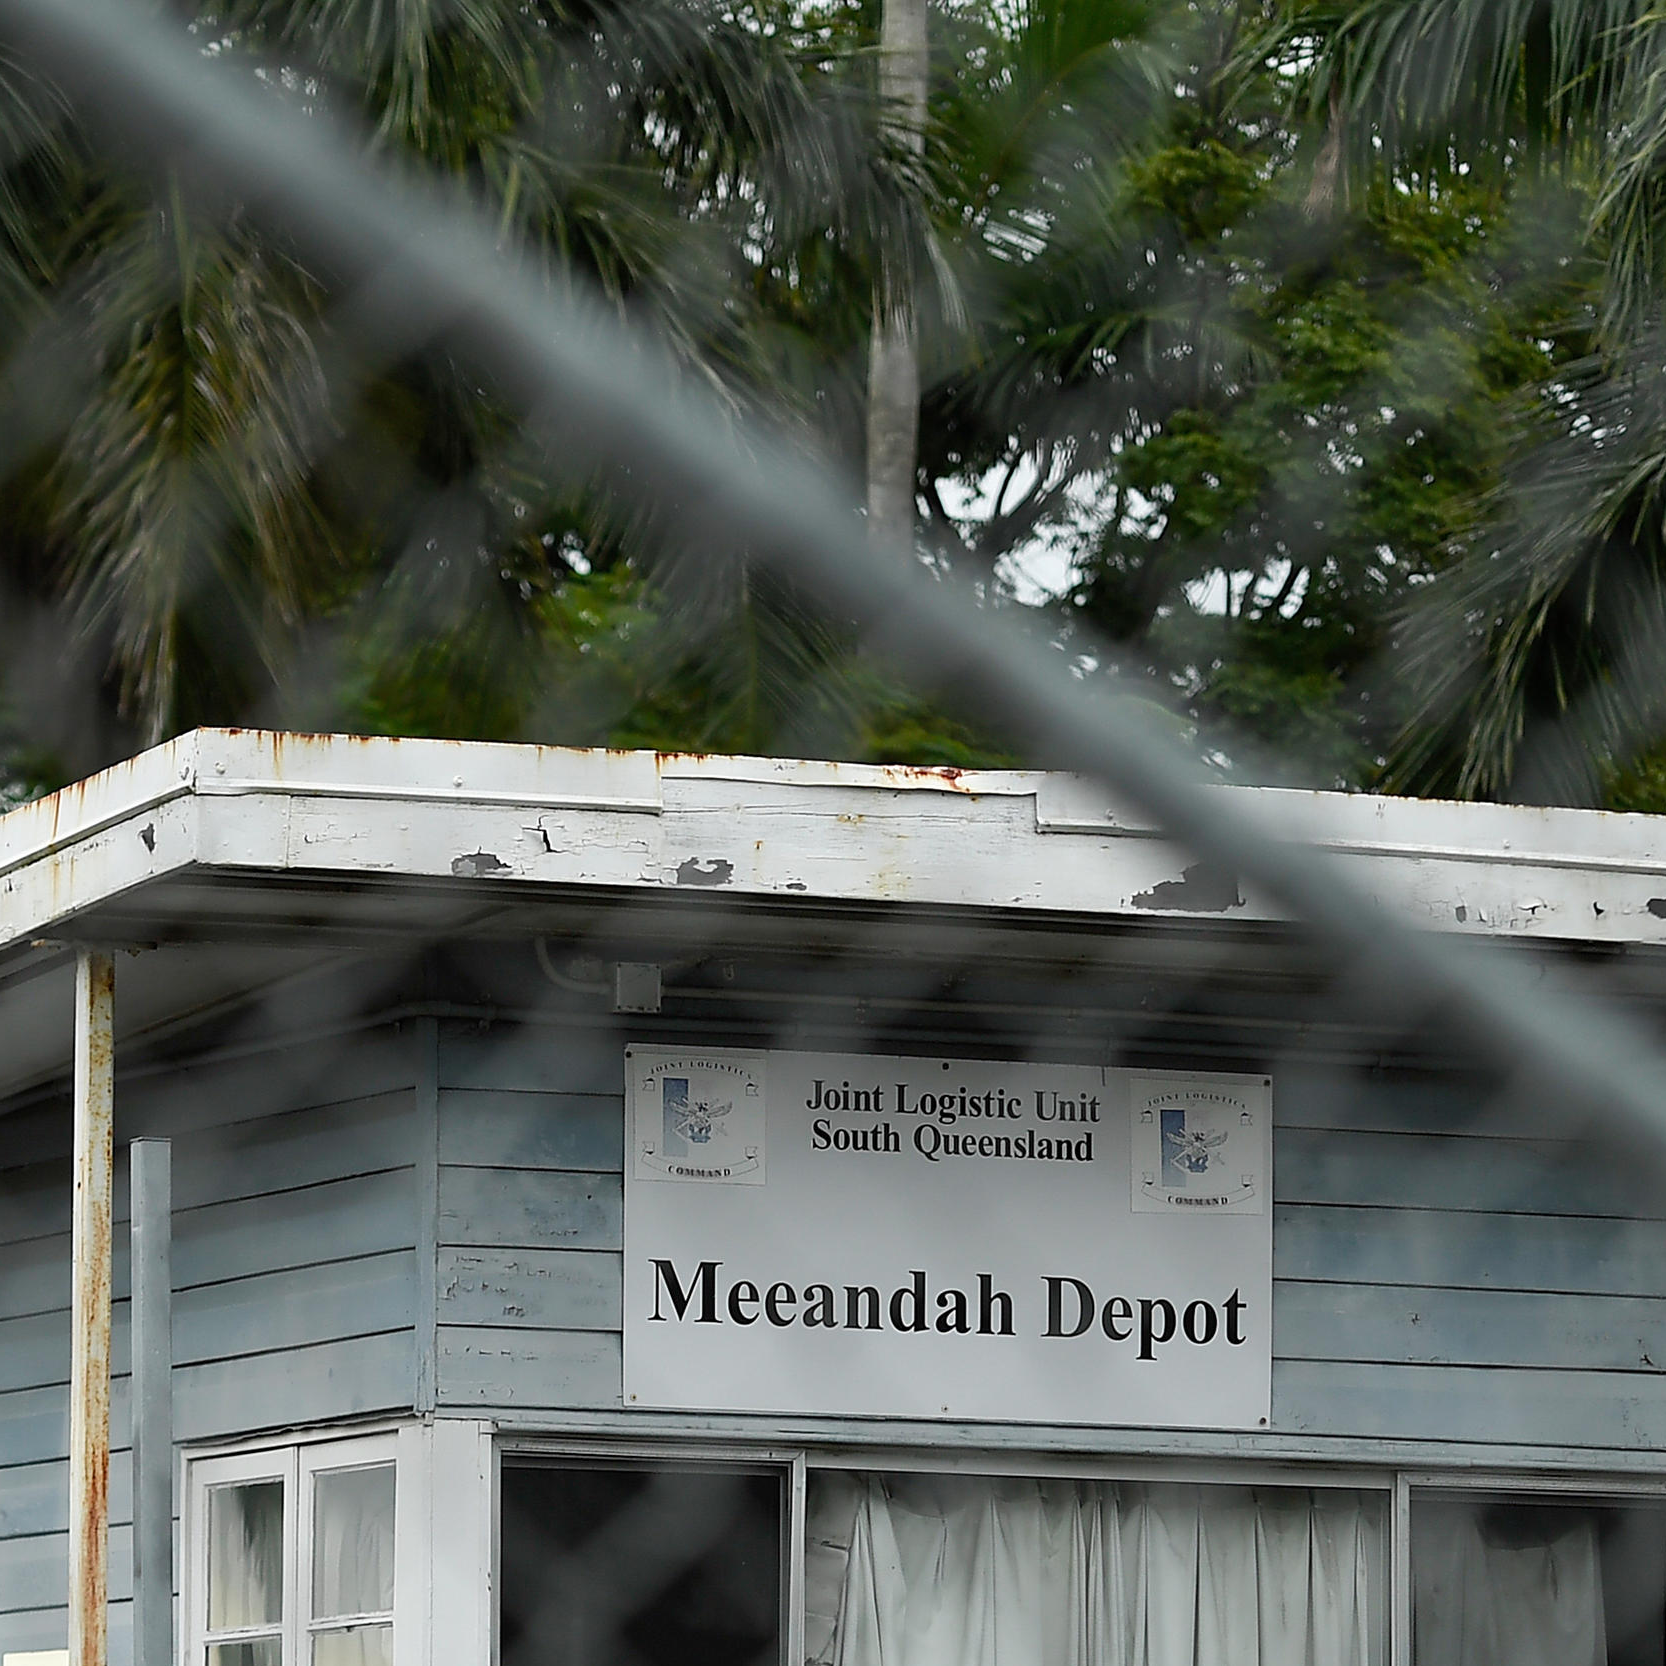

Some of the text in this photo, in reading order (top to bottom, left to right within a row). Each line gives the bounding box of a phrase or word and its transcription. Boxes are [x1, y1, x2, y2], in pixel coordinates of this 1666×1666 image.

[806, 1080, 1101, 1124] Joint Logistic Unit
[812, 1120, 1094, 1162] South Queensland
[668, 1165, 731, 1177] COMMAND
[1168, 1196, 1228, 1206] COMMAND
[648, 1259, 1247, 1361] Meeandah Depot
